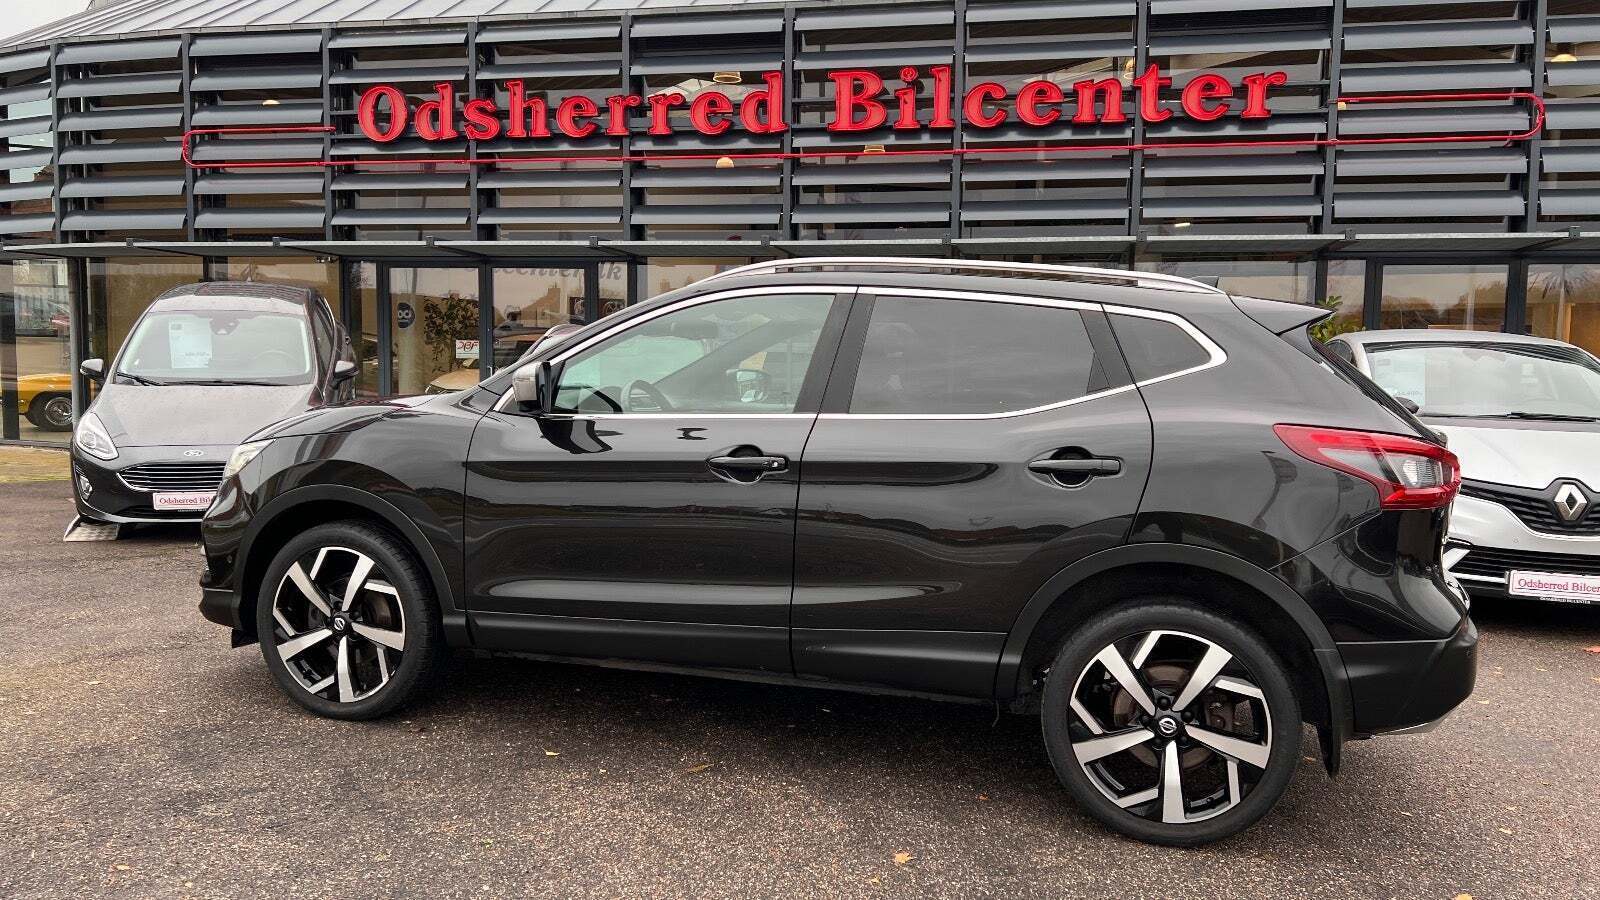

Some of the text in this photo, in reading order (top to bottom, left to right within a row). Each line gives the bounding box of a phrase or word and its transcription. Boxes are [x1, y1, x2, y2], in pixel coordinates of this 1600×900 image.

[357, 63, 1288, 143] Odsherred Bilcenter
[1518, 578, 1569, 591] Odsherred
